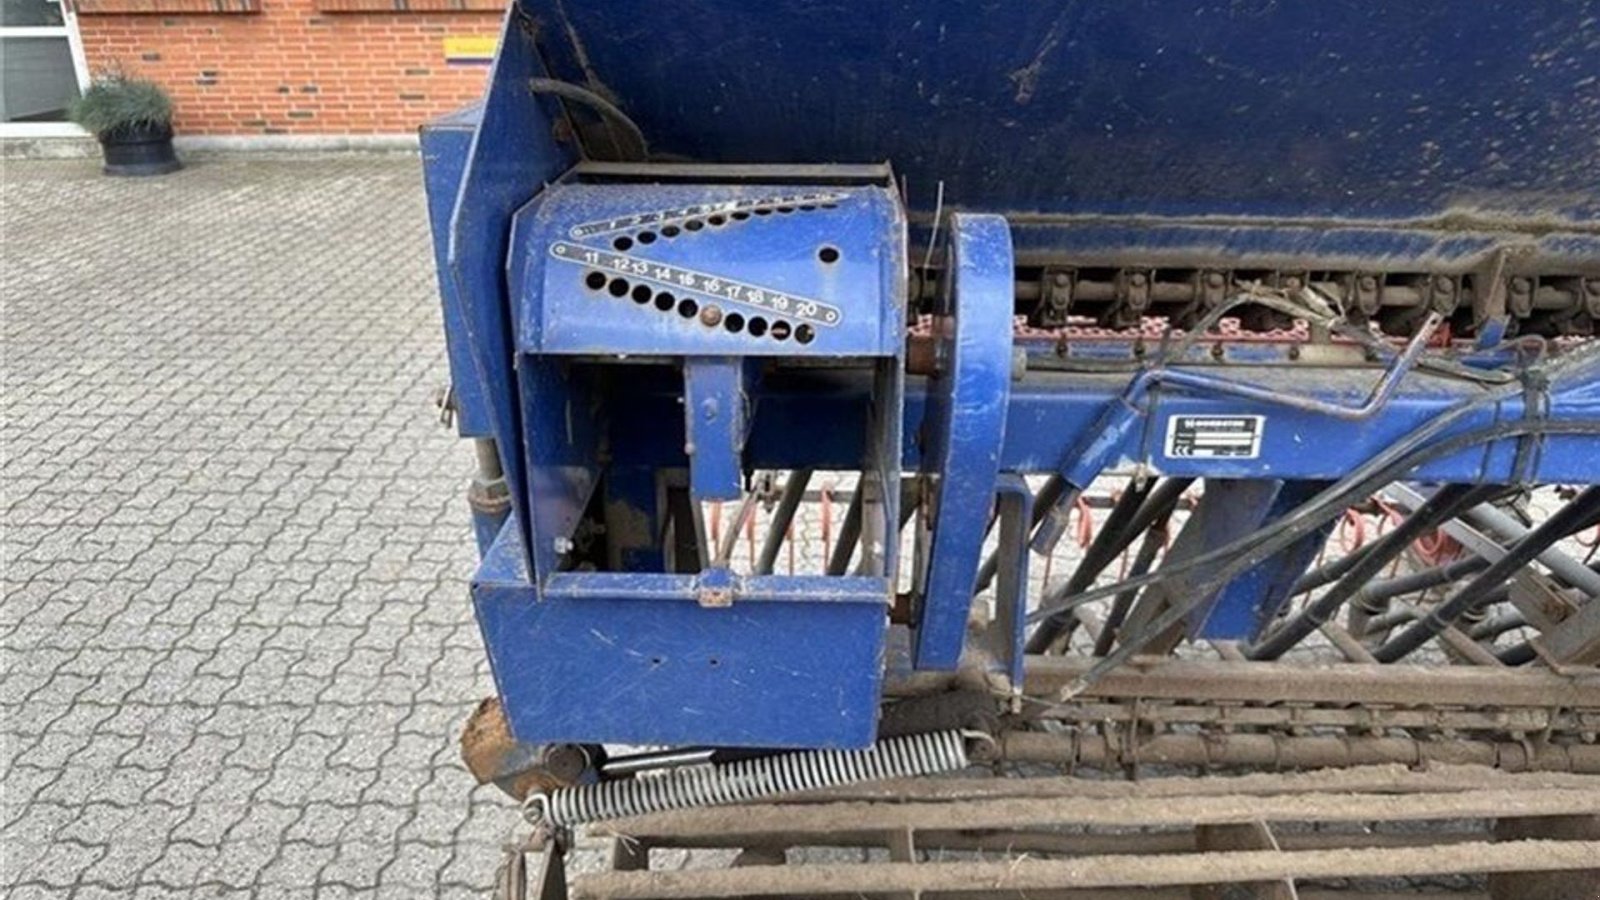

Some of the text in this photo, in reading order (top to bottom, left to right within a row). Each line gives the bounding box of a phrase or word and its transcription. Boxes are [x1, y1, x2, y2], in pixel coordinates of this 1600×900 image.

[585, 252, 598, 264] 11
[613, 258, 630, 270] 12
[632, 262, 648, 274] 13
[654, 268, 671, 279] 14
[703, 279, 720, 292] 16
[726, 285, 742, 298] 17
[746, 290, 764, 303] 18
[771, 296, 788, 310] 19
[795, 302, 817, 316] 20
